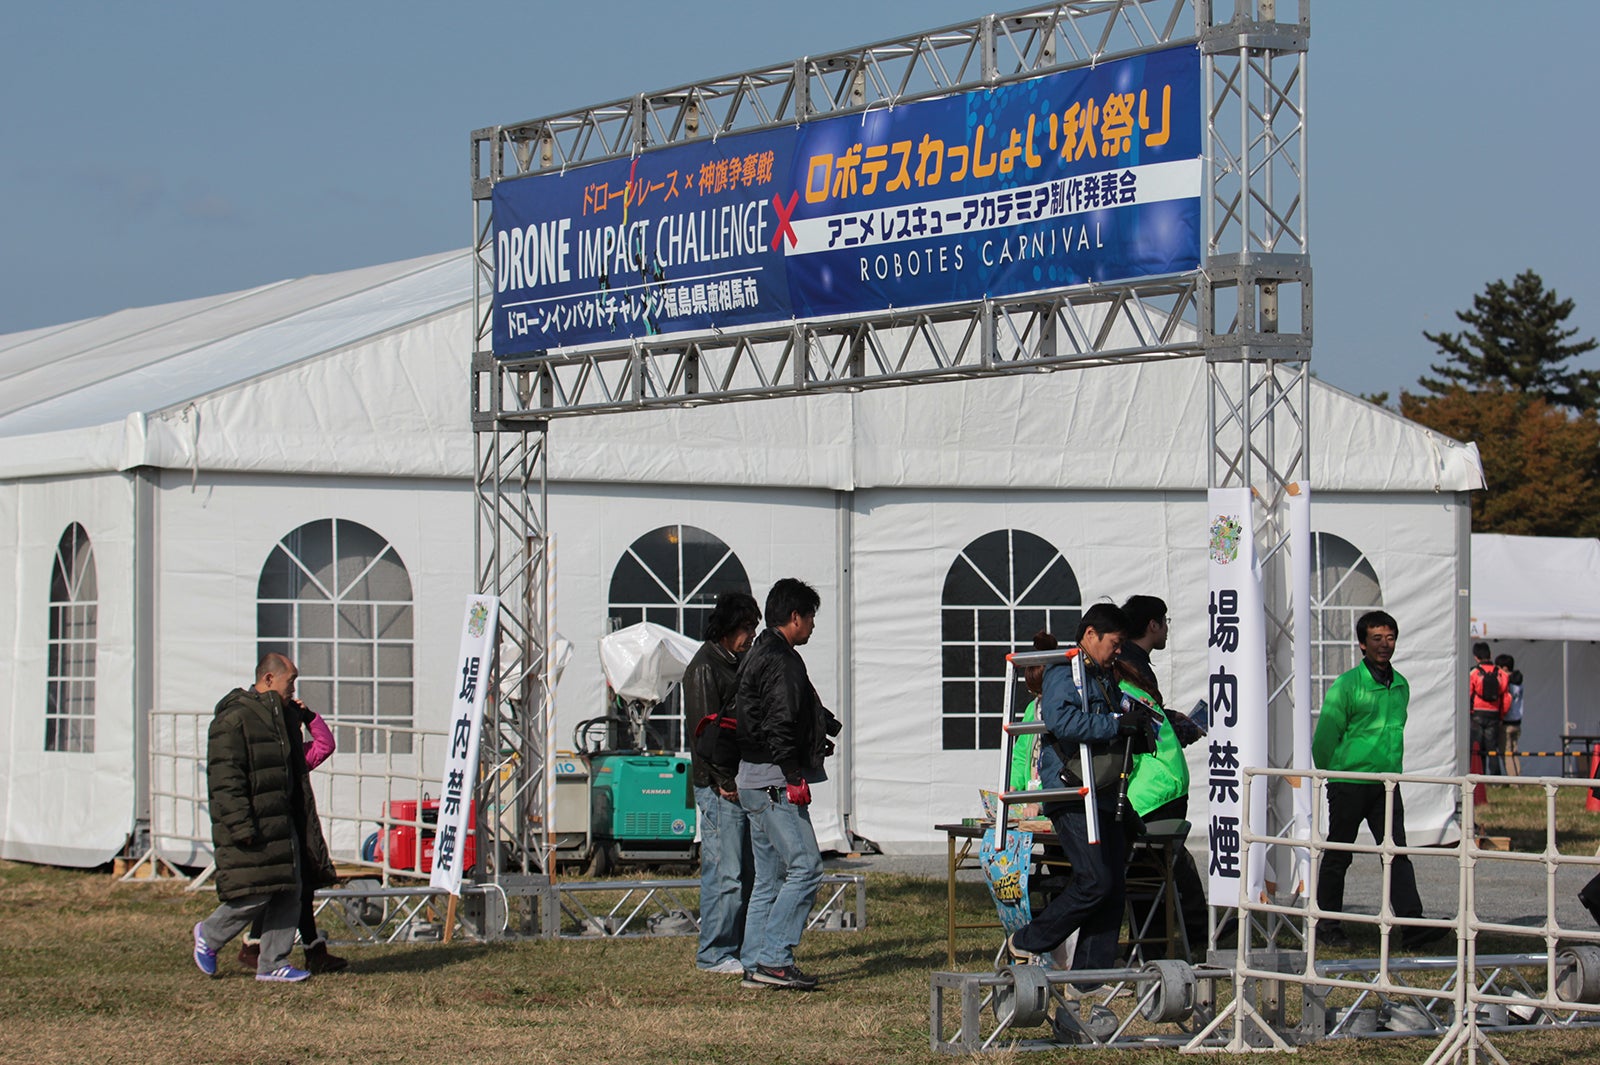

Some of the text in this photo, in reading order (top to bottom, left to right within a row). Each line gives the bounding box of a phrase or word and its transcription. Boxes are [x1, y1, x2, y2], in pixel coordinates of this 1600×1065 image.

[583, 169, 680, 216] ドローンレース
[699, 150, 775, 197] 神旗争奪戦
[805, 84, 1171, 204] ロボテスわっしょい秋祭り
[498, 199, 769, 292] DRONE IMPACT CHALLENGE
[860, 222, 1104, 281] ROBOTES CARNIVAL
[508, 276, 759, 339] ドローンインパクトチャレンジ福島県南相馬市
[437, 656, 481, 871] 場内禁煙
[1208, 589, 1241, 878] 場内禁煙
